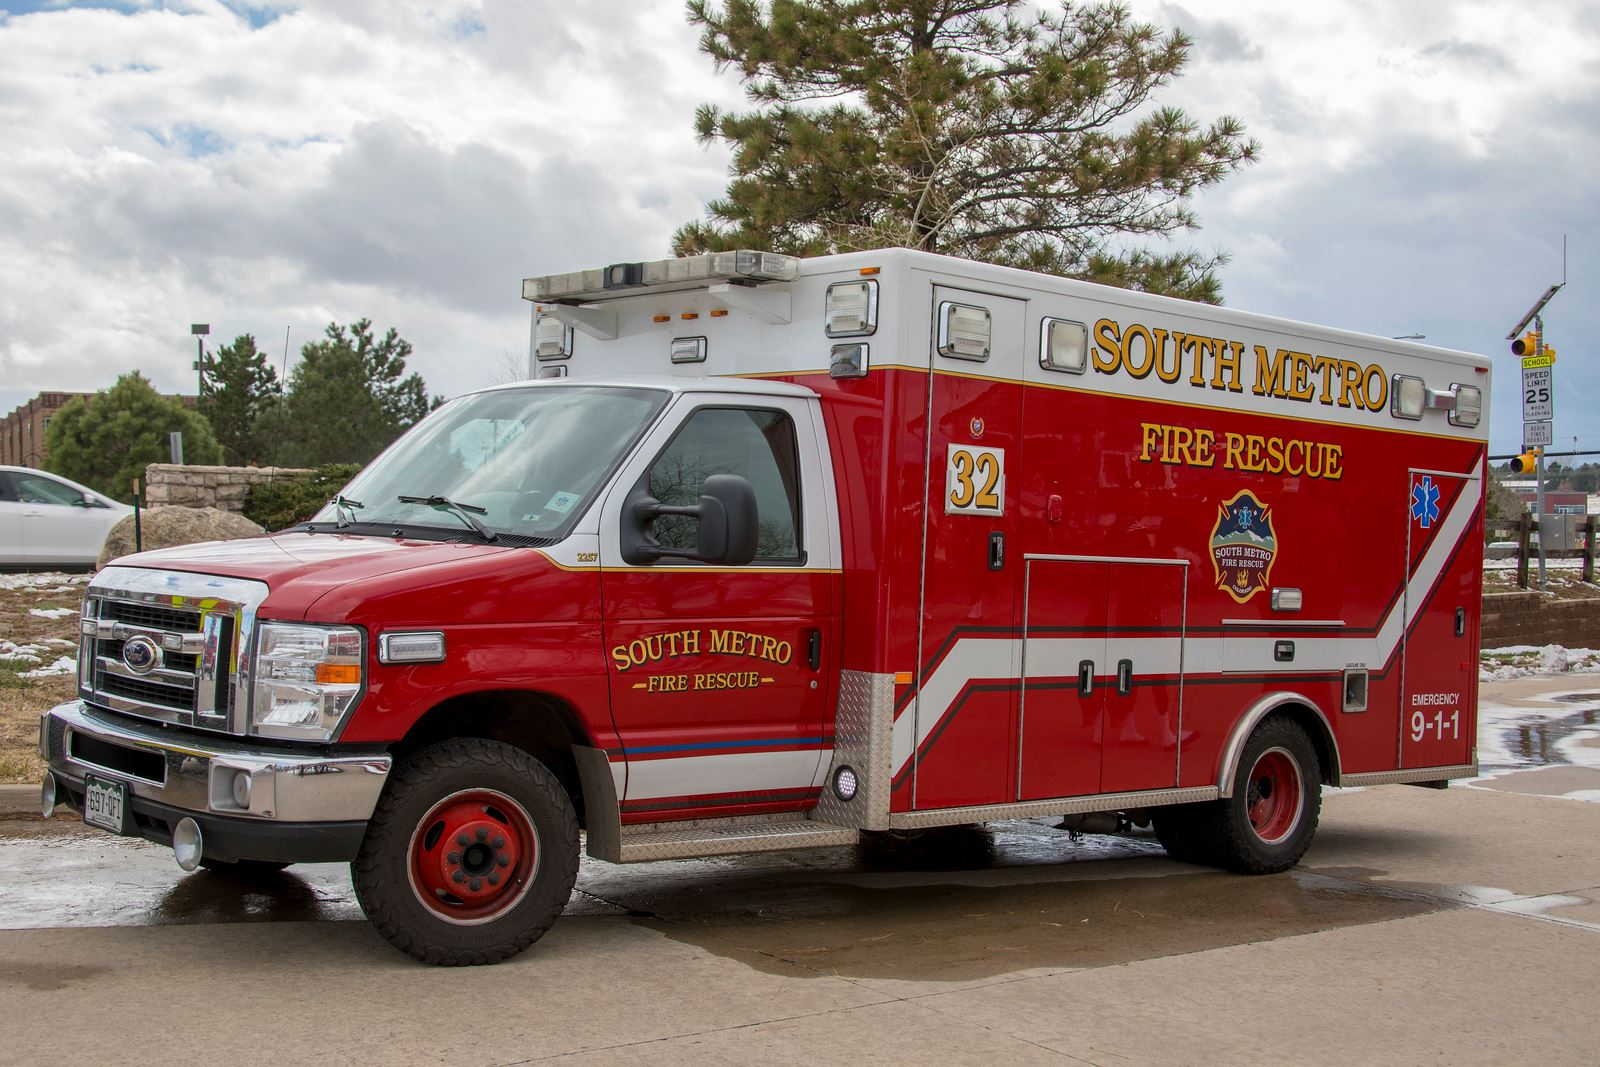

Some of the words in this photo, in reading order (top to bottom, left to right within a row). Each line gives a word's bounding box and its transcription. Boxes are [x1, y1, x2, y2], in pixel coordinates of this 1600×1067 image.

[1091, 317, 1244, 393] SOUTH
[1252, 345, 1389, 412] METRO
[1523, 358, 1549, 367] SCHOOL
[1525, 371, 1549, 379] SPEED
[1527, 379, 1546, 387] LIMIT
[1525, 388, 1549, 404] 25
[1139, 422, 1216, 468] FIRE
[1224, 432, 1343, 480] RESCUE
[950, 450, 999, 510] 32
[1215, 547, 1242, 559] SOUTH
[1243, 547, 1271, 561] METRO
[1221, 559, 1238, 567] FIRE
[1238, 559, 1264, 568] RESCUE
[1232, 584, 1252, 593] COLORADO
[611, 629, 700, 673] SOUTH
[709, 629, 792, 666] METRO
[647, 675, 688, 693] FIRE
[694, 671, 760, 691] RESCUE
[1412, 693, 1459, 706] EMERGENCY
[1411, 709, 1459, 742] 9-1-1
